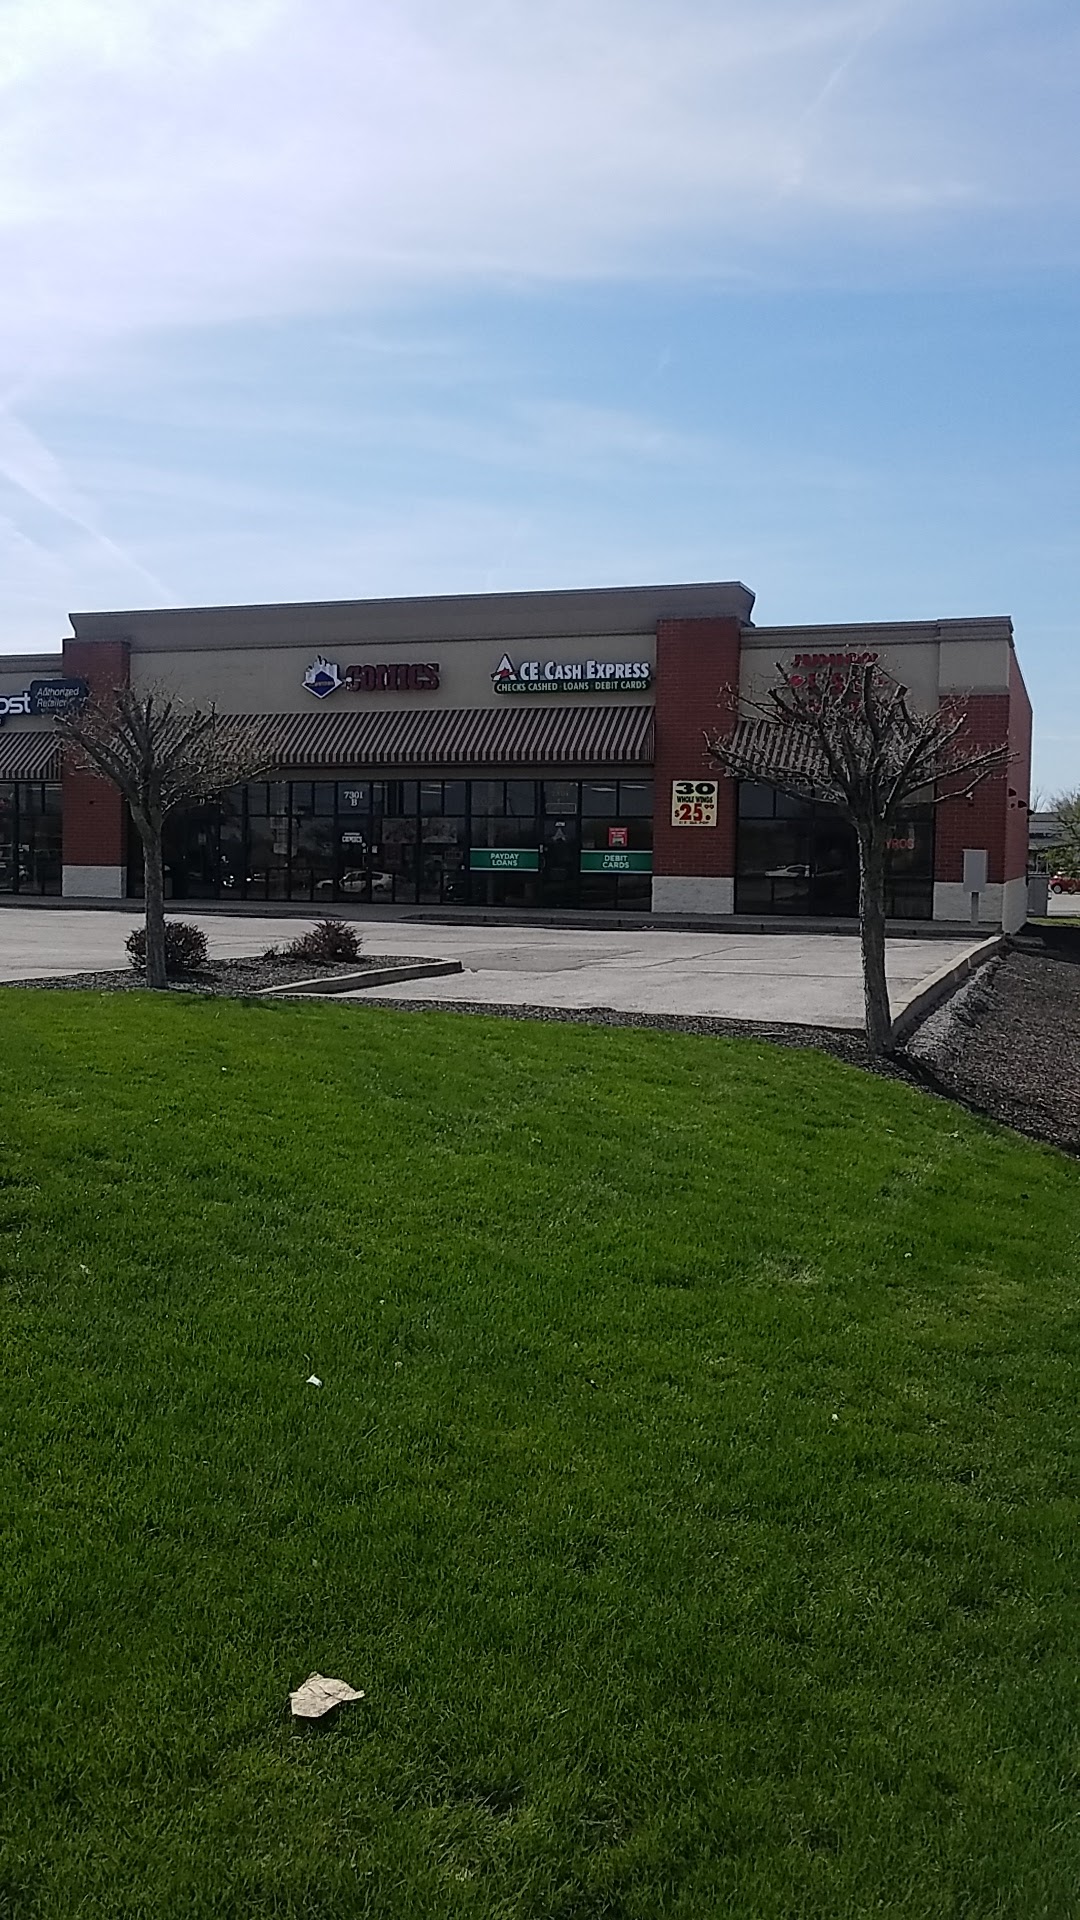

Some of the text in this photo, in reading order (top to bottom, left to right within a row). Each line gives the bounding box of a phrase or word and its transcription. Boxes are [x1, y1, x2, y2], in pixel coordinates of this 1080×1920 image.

[491, 652, 540, 681] ACE
[496, 680, 647, 692] CHECKS CASHED LOANS DEBIT CARDS
[37, 687, 79, 697] Authorized
[37, 698, 67, 708] Retailer
[675, 782, 716, 795] 30
[344, 791, 363, 799] 7301
[351, 798, 358, 806] B
